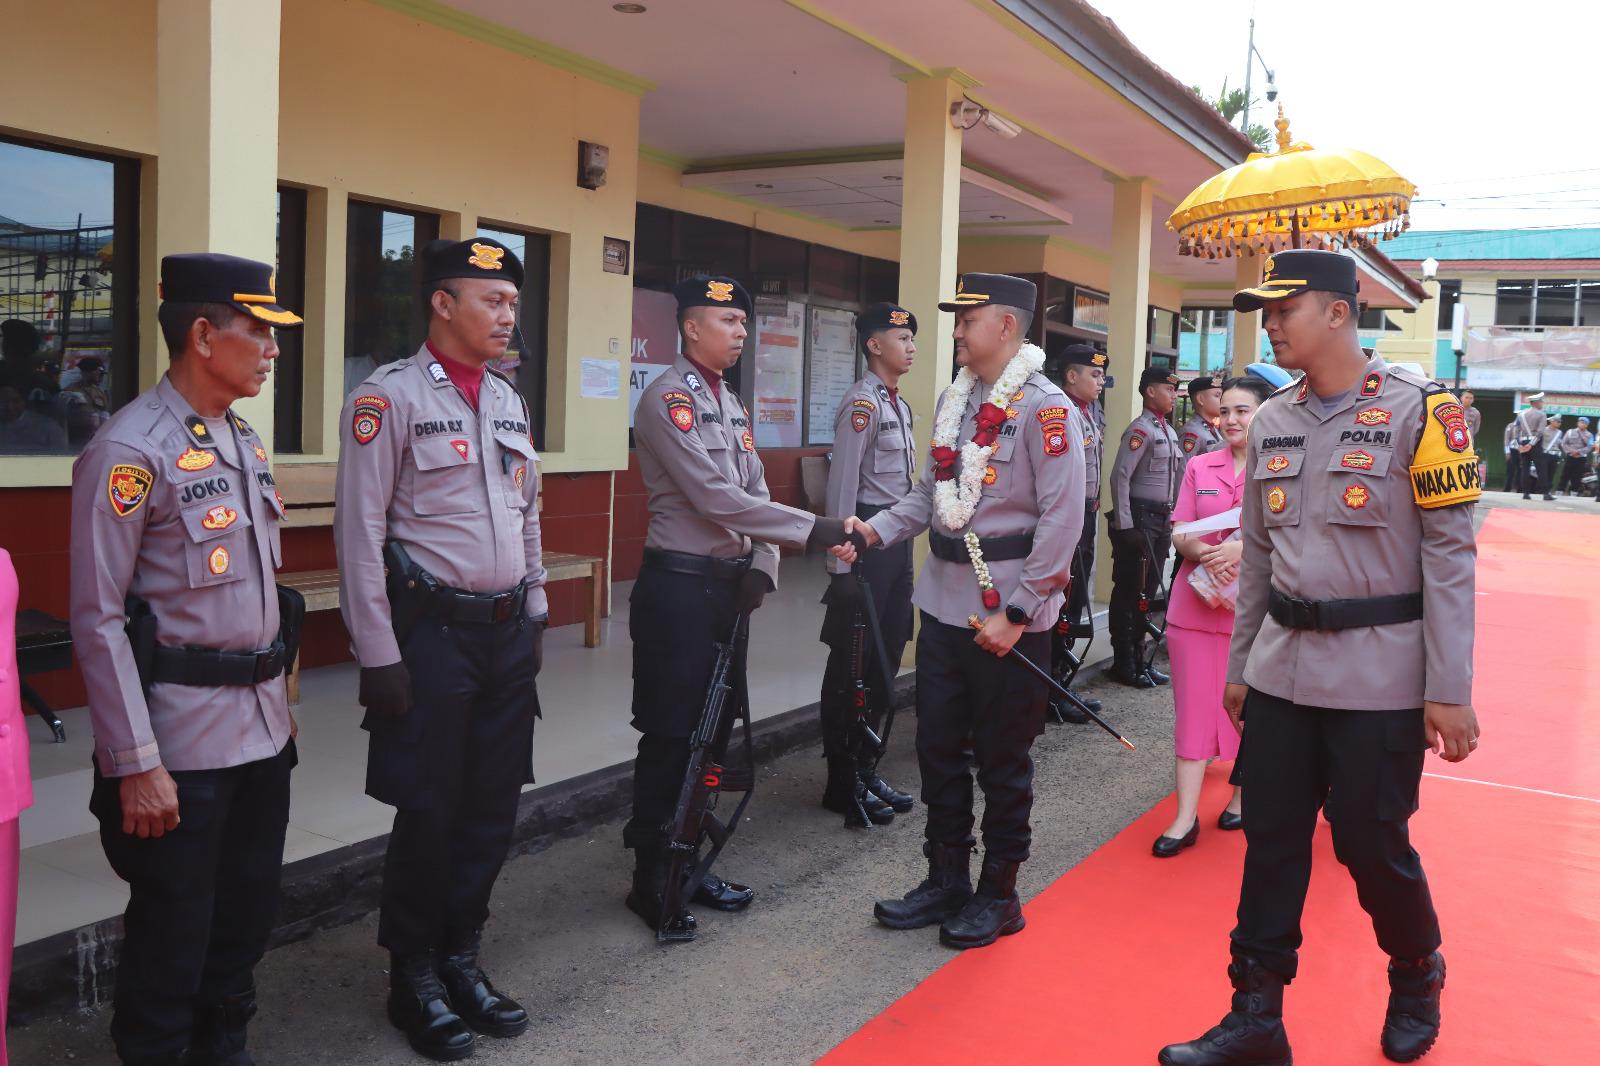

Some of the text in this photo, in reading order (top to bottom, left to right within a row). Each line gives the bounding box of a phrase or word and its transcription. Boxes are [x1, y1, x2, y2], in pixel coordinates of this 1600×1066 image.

[414, 420, 447, 436] DENA
[493, 419, 528, 435] POLRI
[1340, 429, 1392, 445] POLRI
[181, 477, 230, 503] JOKO
[1412, 465, 1459, 499] WAKA
